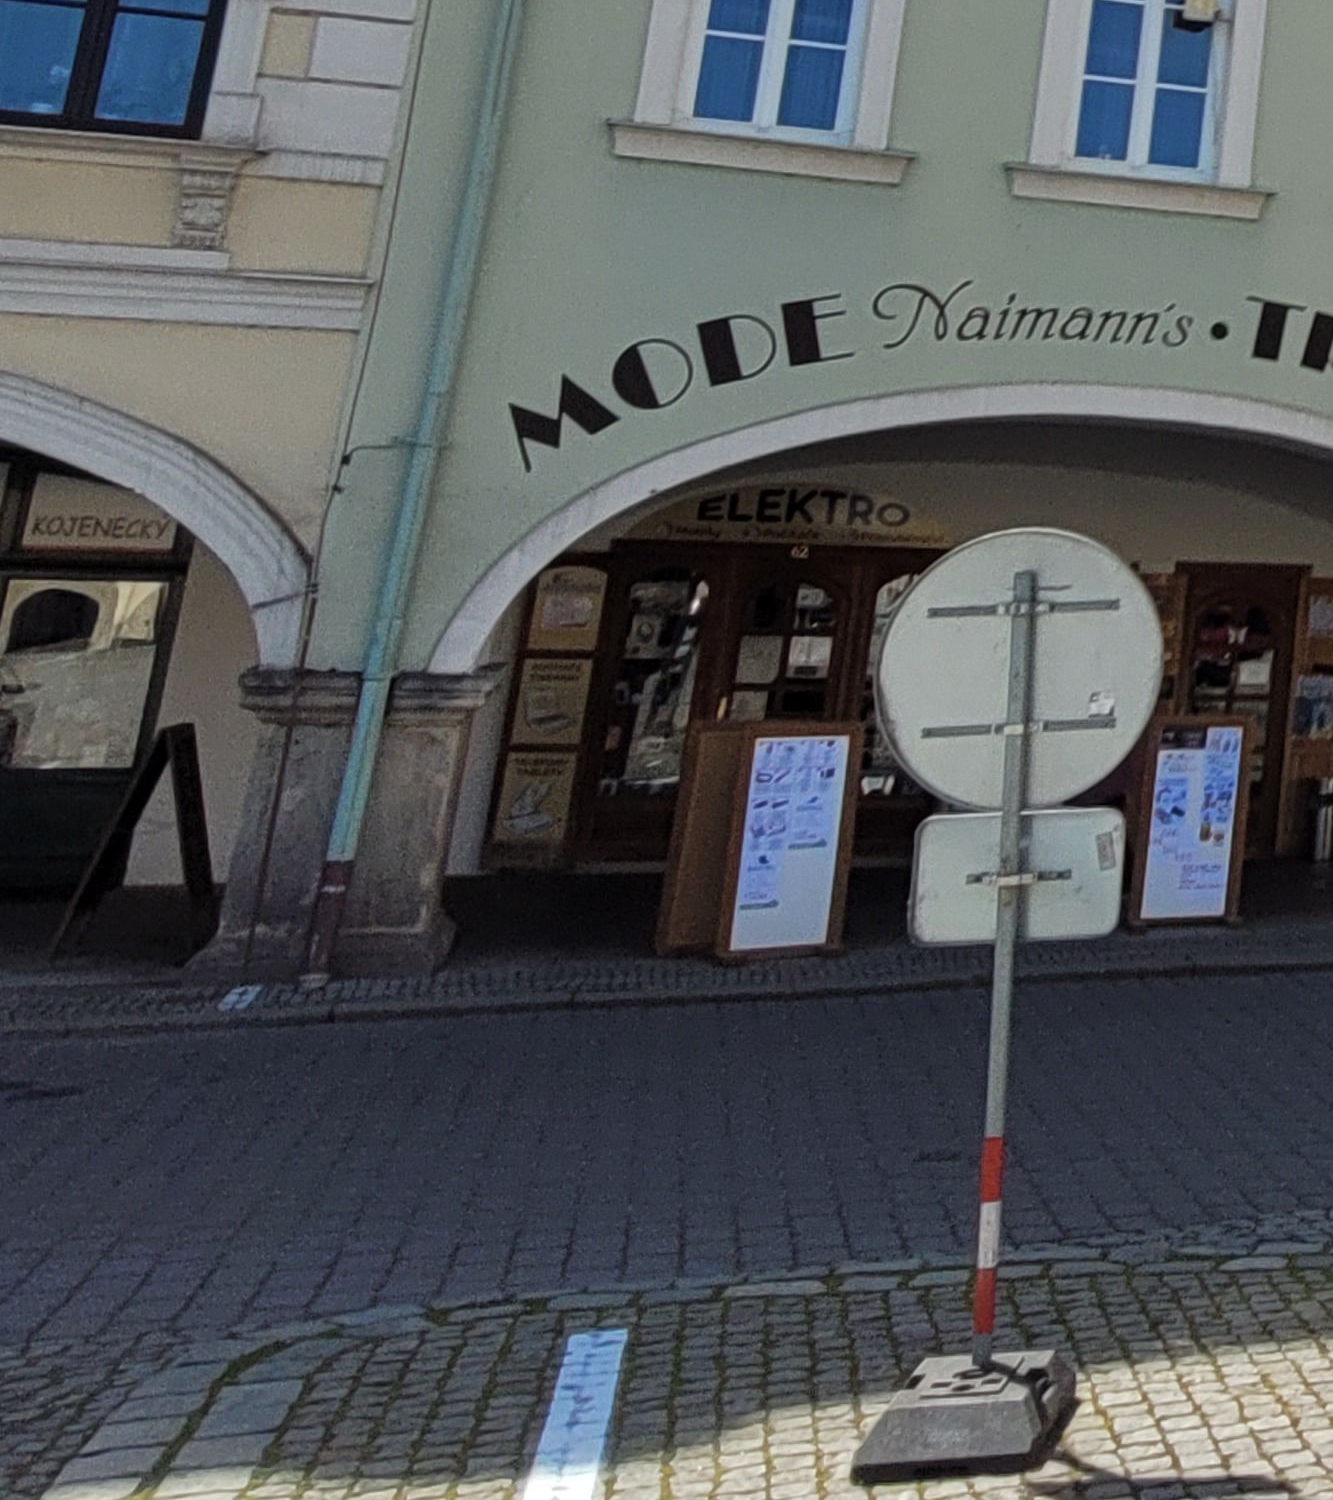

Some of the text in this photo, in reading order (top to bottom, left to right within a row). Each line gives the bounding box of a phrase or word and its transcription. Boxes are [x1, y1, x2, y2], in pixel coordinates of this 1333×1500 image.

[509, 293, 856, 473] MODE
[872, 280, 1193, 349] Naimann's
[697, 488, 911, 527] ELEKTRO
[791, 545, 809, 559] 62
